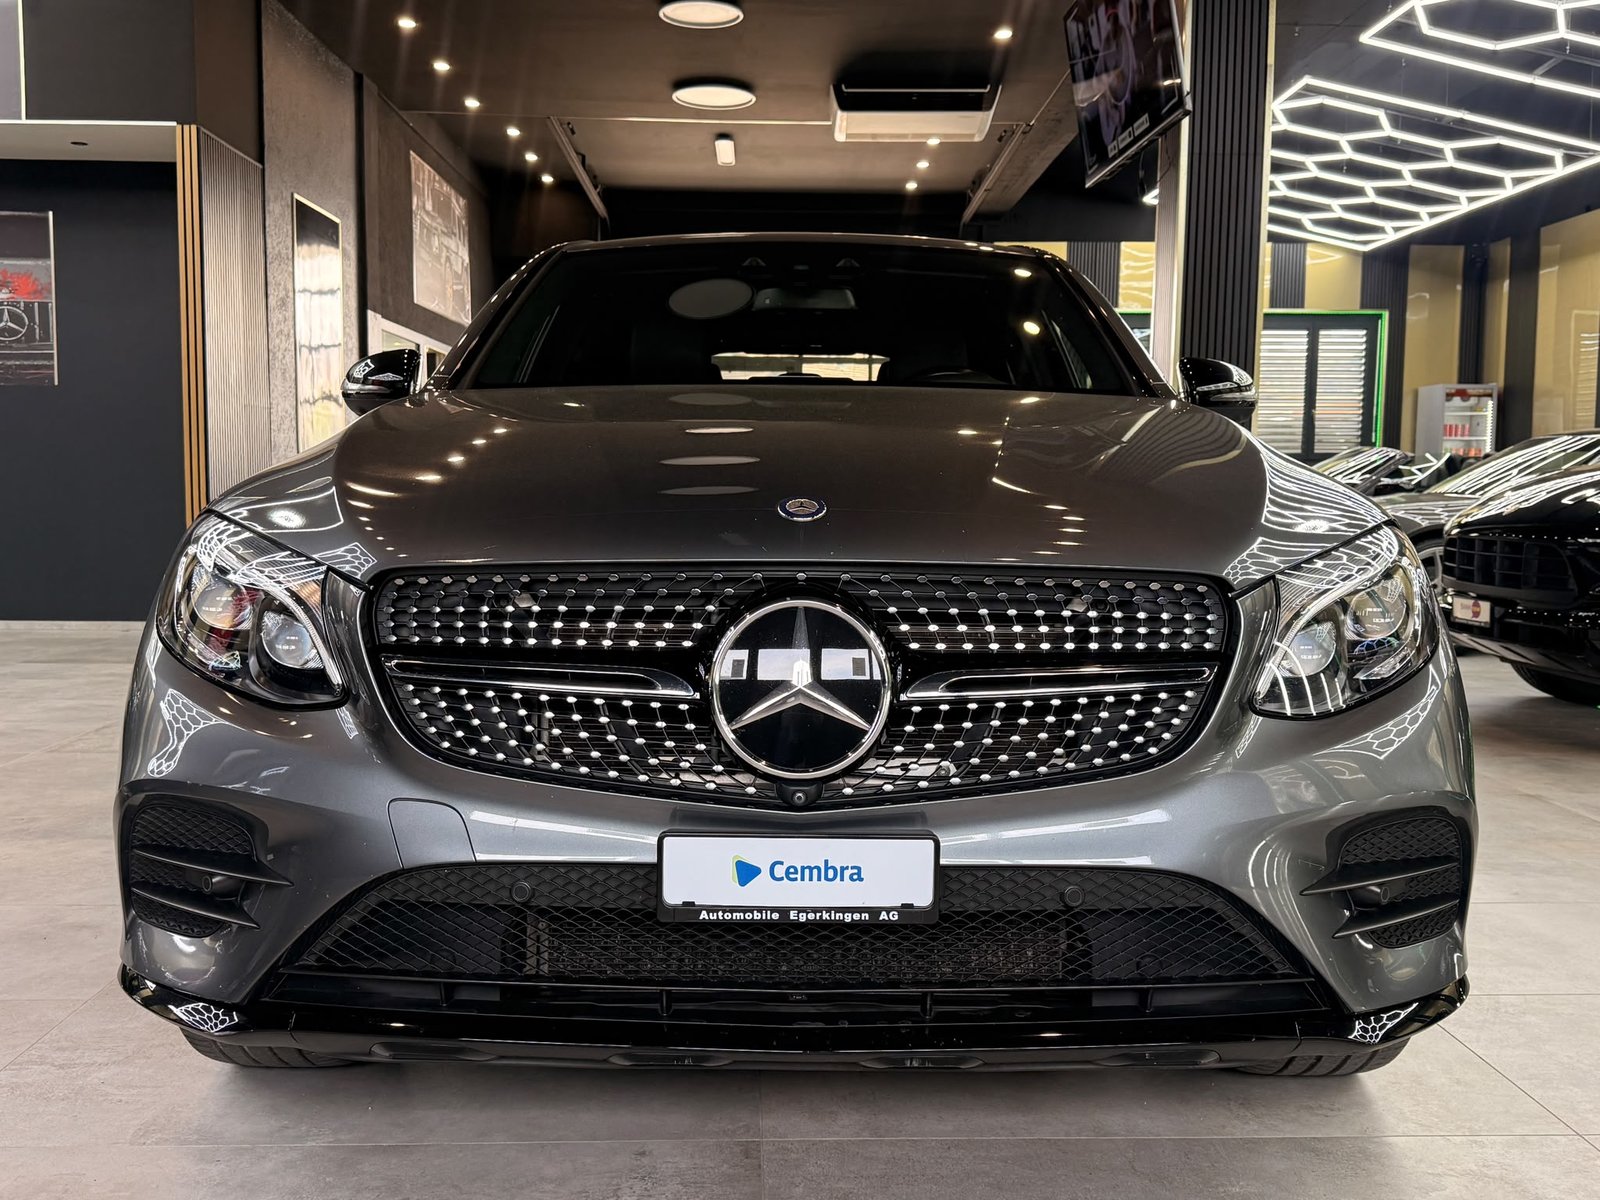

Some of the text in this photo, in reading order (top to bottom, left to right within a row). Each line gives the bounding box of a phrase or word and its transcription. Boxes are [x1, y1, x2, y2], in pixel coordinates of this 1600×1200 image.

[769, 858, 864, 882] Cembra
[699, 910, 899, 922] Automobile Egerkingen AG
